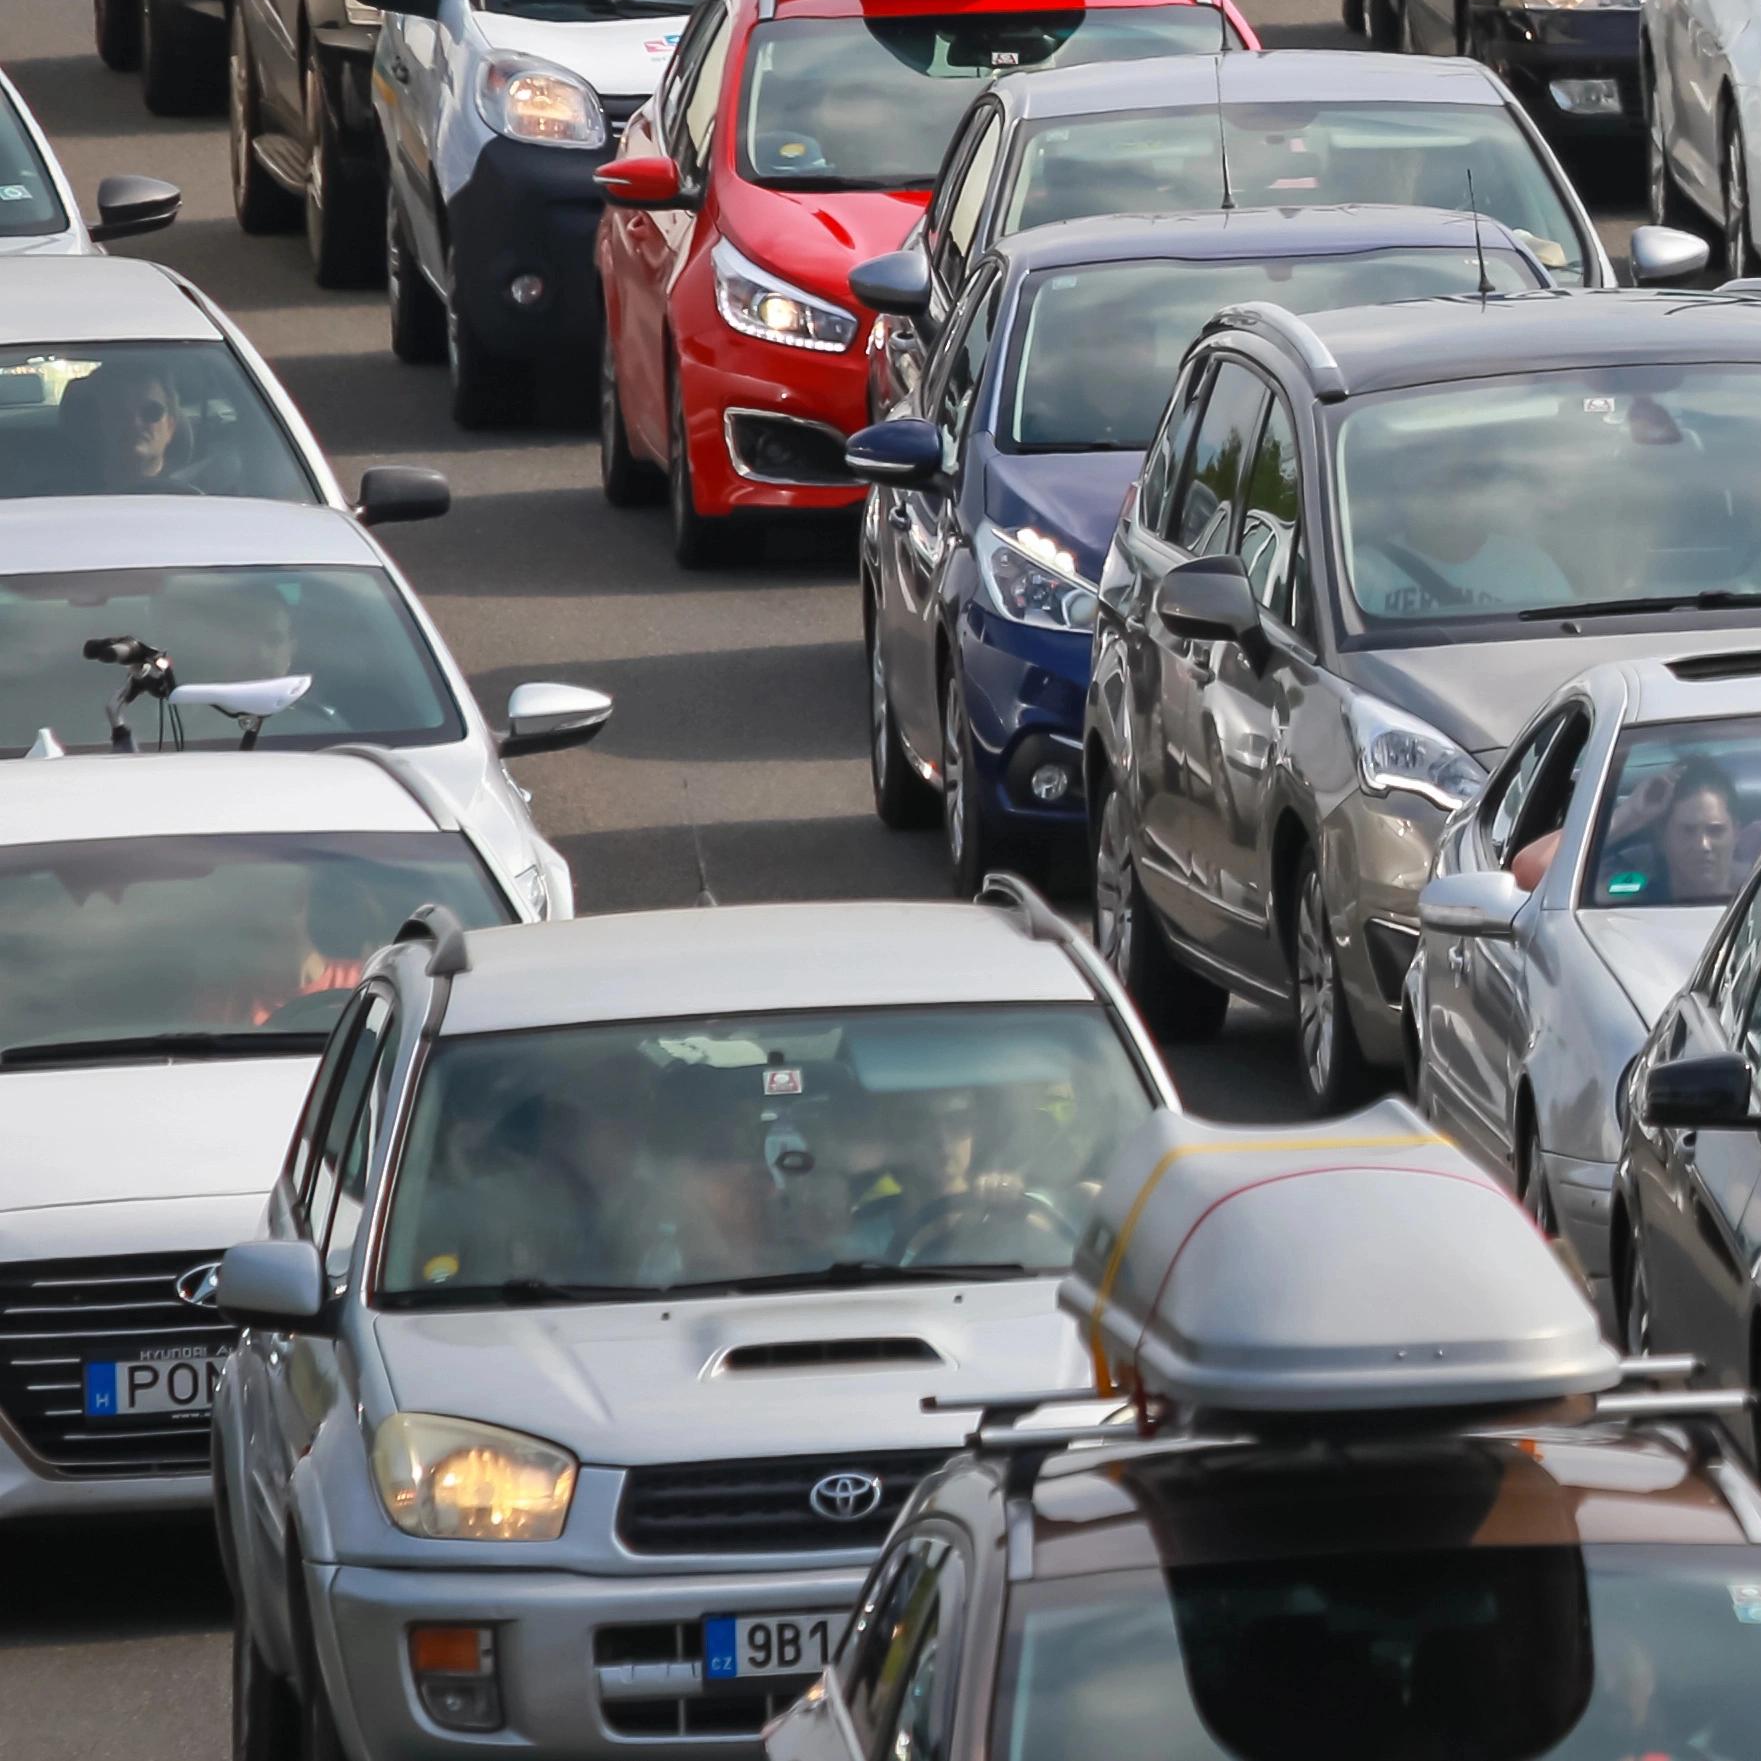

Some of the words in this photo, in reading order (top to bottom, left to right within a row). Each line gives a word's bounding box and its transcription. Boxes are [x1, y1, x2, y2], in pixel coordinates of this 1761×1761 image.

[96, 1393, 109, 1408] H
[711, 1655, 733, 1671] CZ
[748, 1620, 829, 1669] 9B1
